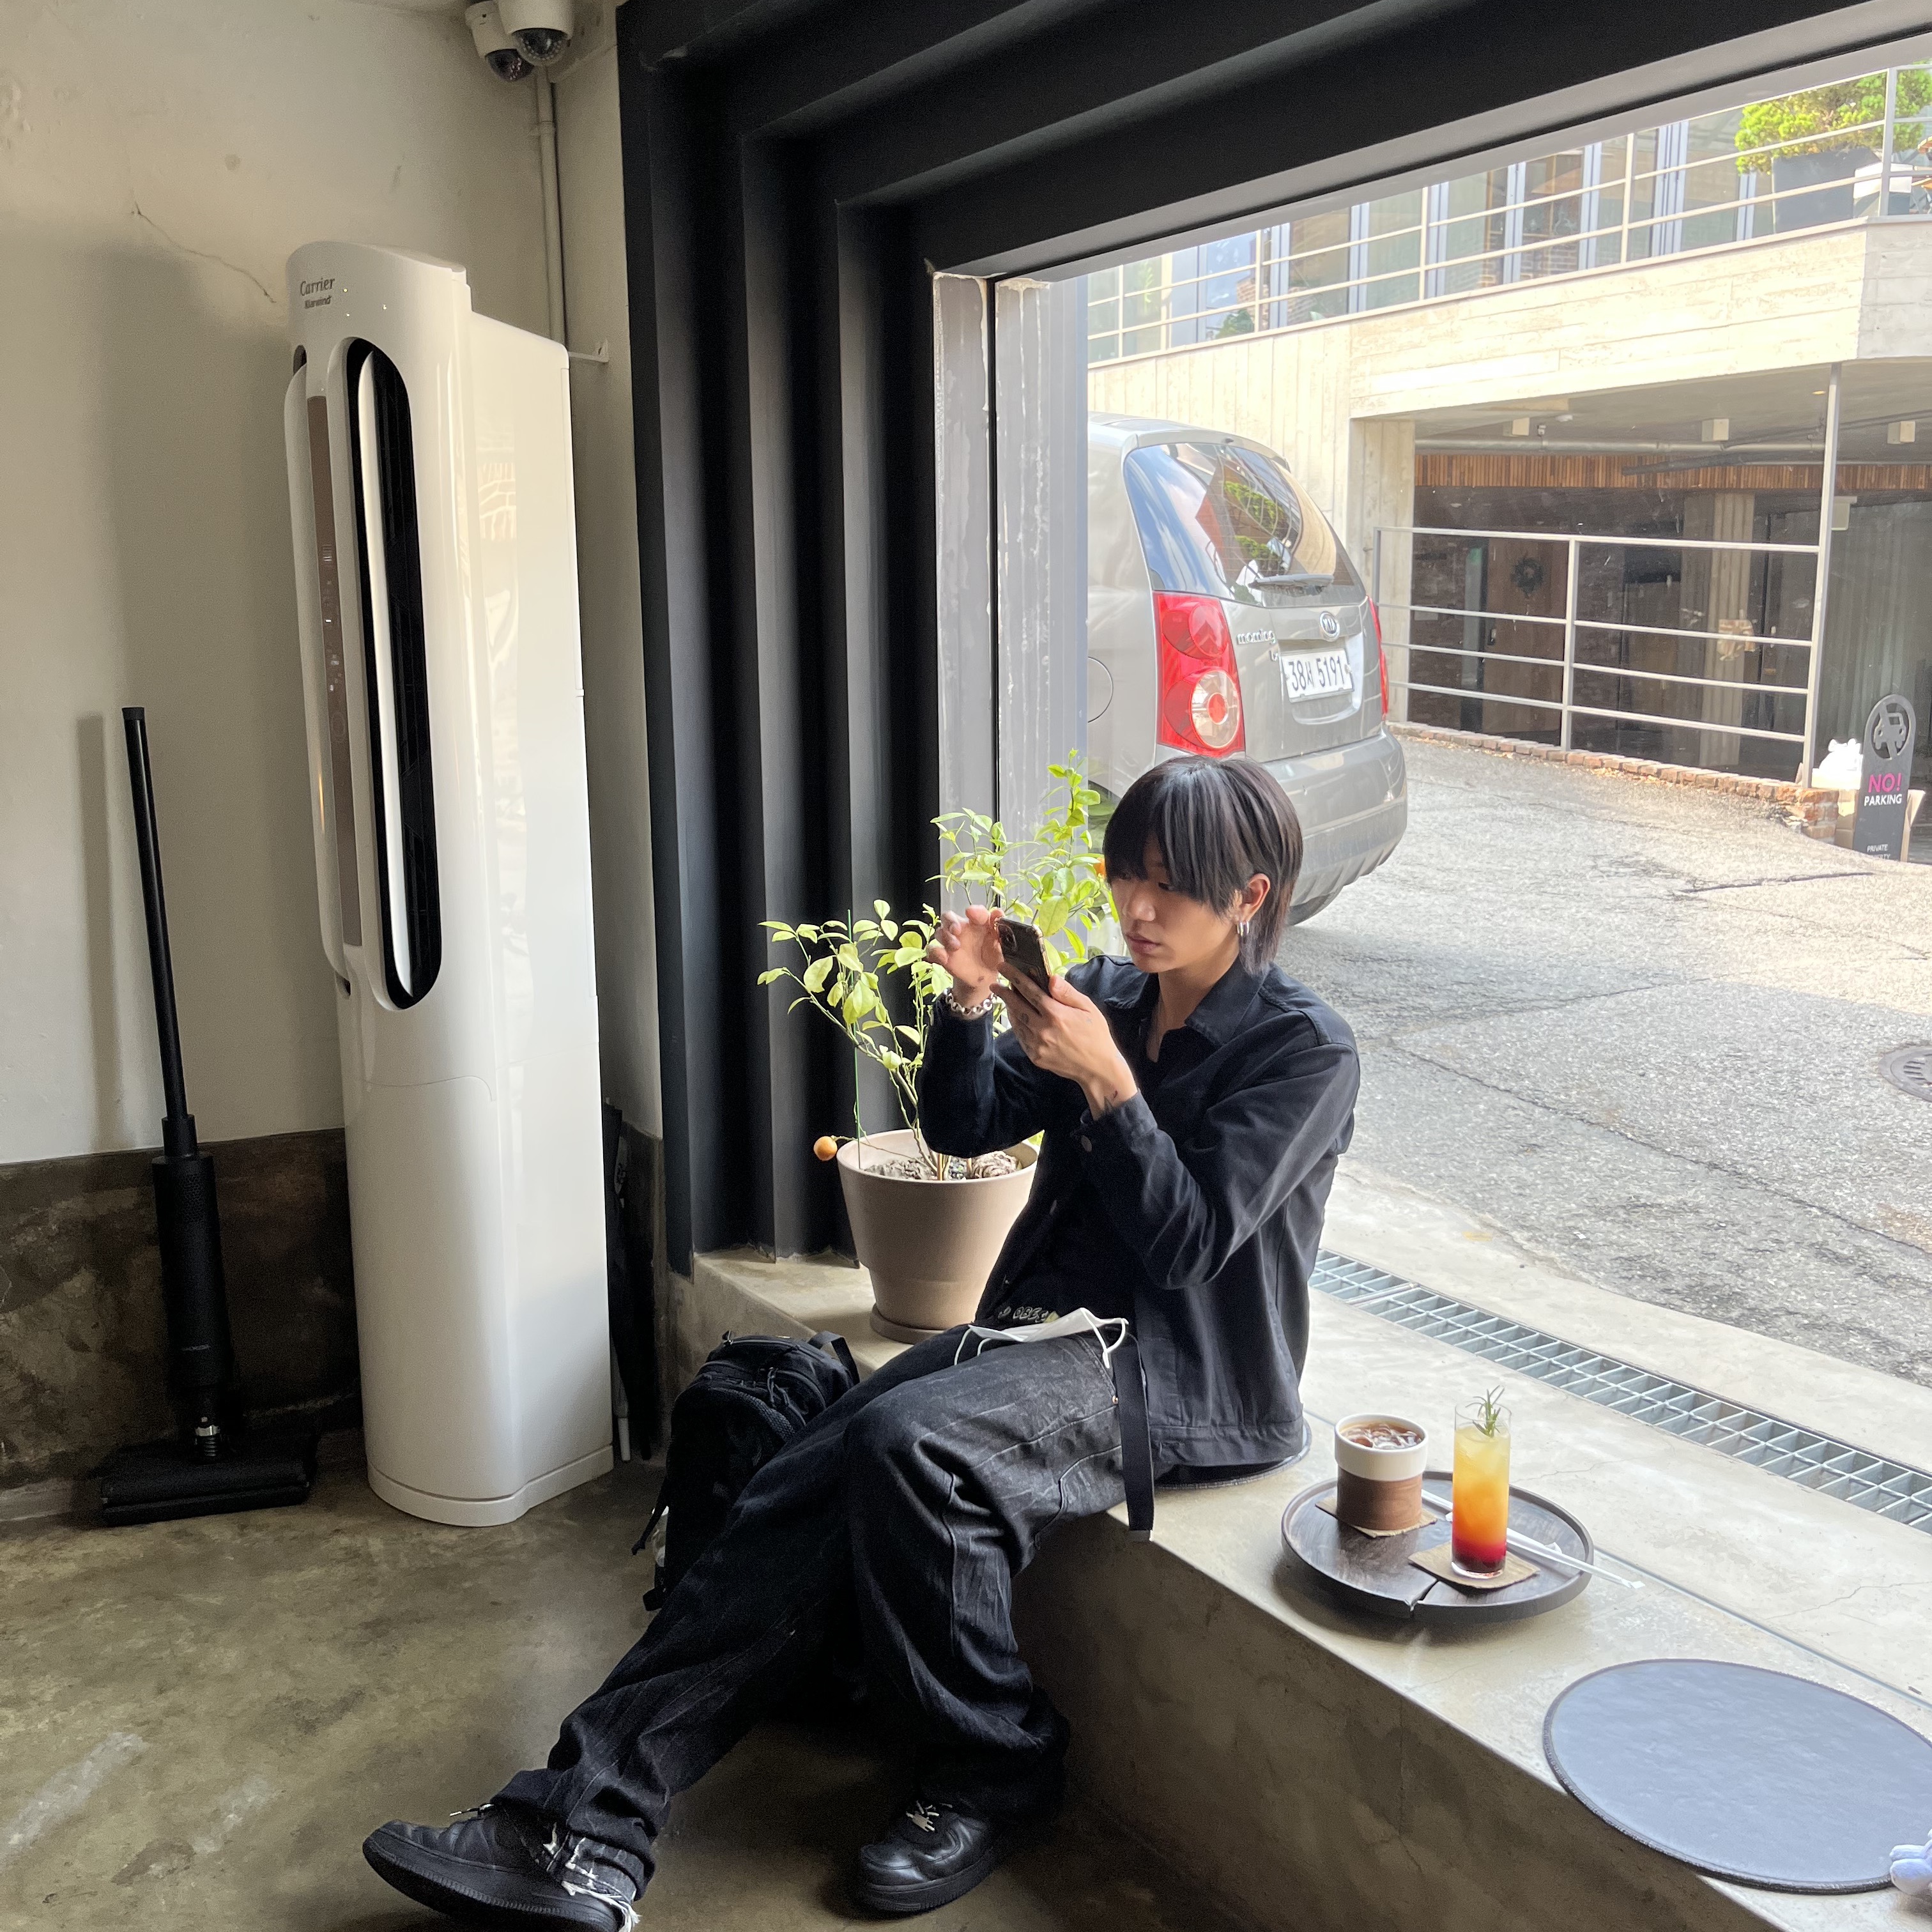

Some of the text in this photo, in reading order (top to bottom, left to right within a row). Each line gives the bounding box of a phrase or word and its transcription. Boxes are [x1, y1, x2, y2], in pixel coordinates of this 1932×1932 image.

[300, 277, 335, 296] Carrier
[1316, 656, 1345, 687] 5191
[1868, 772, 1902, 793] NO!
[1864, 793, 1903, 807] PARKING
[1867, 844, 1888, 853] PRIVATE
